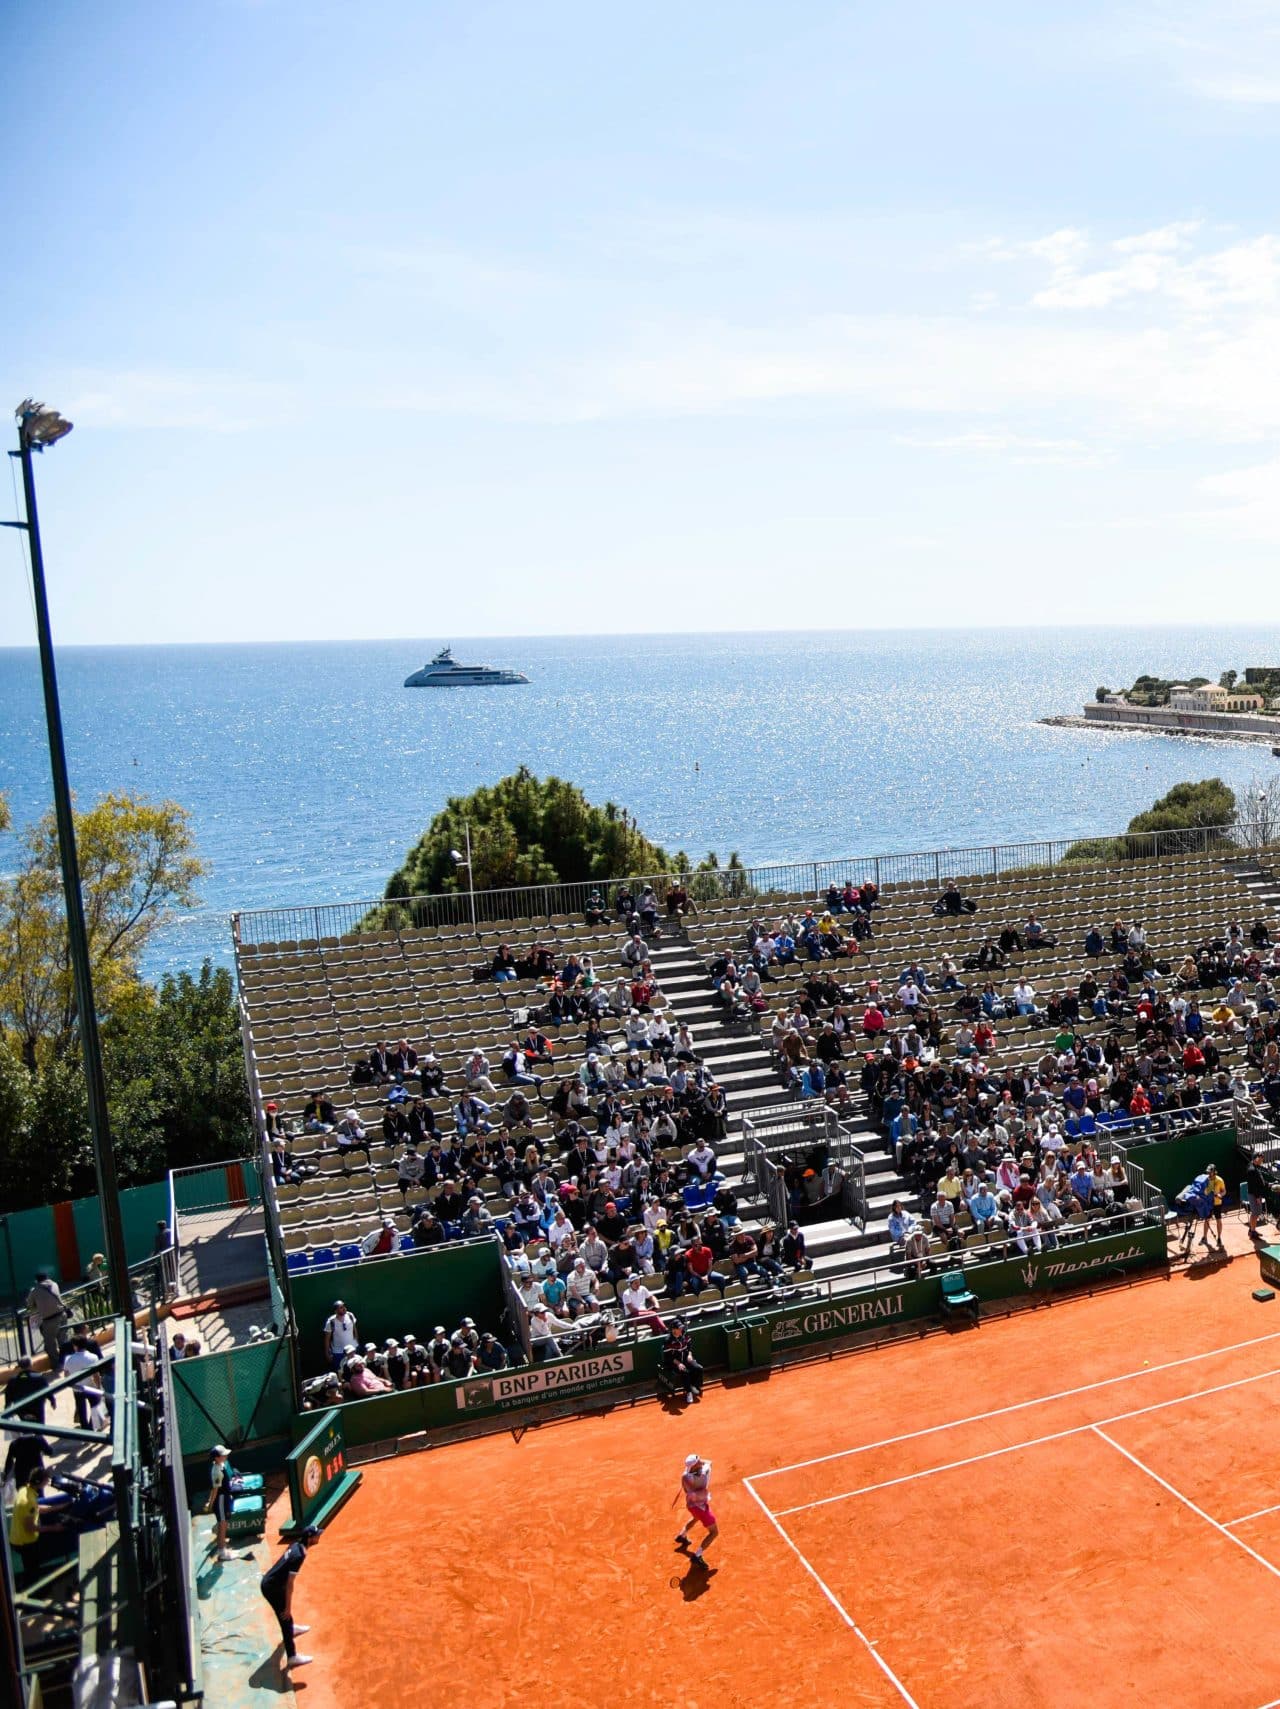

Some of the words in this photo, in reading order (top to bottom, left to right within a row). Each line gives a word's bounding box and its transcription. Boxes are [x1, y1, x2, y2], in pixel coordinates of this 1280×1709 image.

[1044, 1246, 1145, 1277] Maserati
[803, 1294, 904, 1334] GENERALI
[734, 1331, 741, 1339] 2
[499, 1374, 540, 1396] BNP
[544, 1355, 624, 1387] PARIBAS
[501, 1399, 511, 1408] La
[512, 1393, 539, 1408] banque
[541, 1390, 558, 1401] d'un
[559, 1384, 584, 1396] monde
[586, 1380, 598, 1393] qui
[599, 1374, 625, 1387] change
